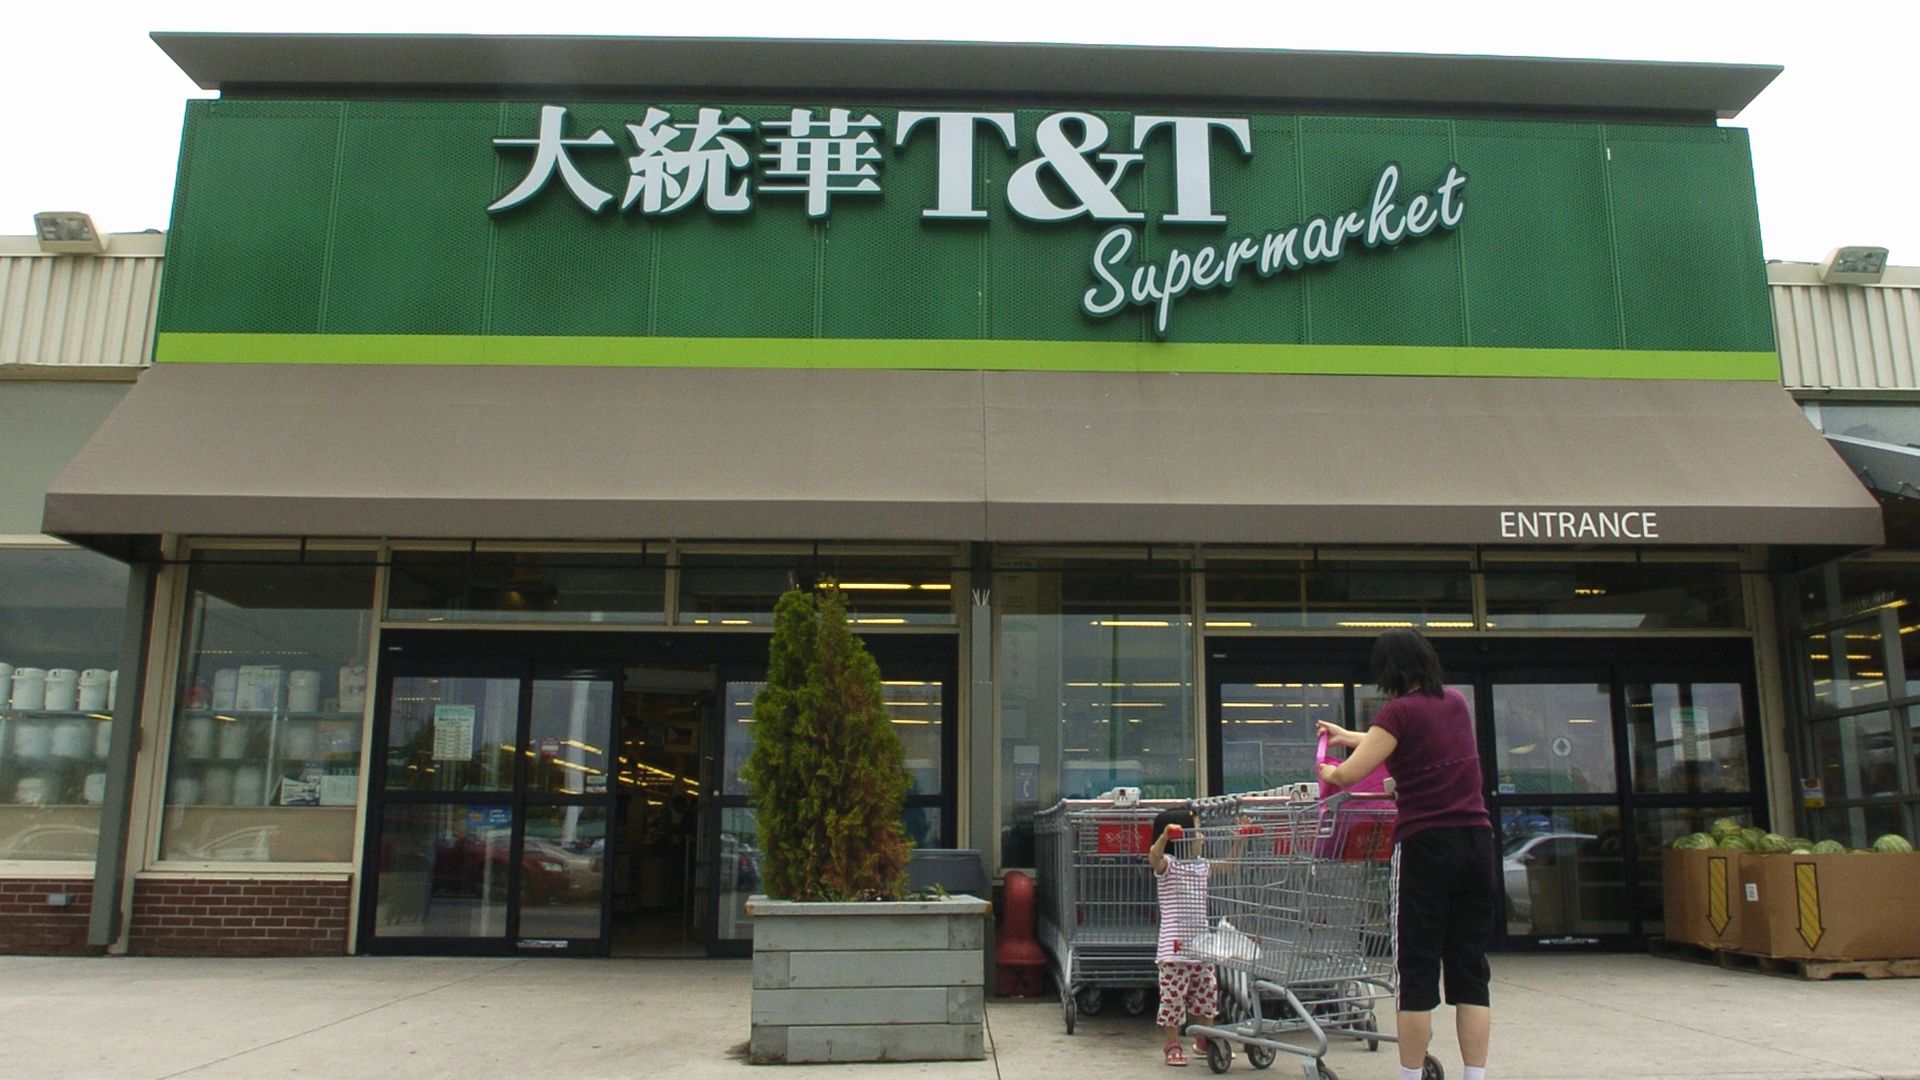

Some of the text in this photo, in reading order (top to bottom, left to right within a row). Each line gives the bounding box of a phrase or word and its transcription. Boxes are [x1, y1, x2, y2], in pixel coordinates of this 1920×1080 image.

[488, 105, 882, 217] 大統華
[896, 111, 1252, 223] T&T
[1083, 165, 1466, 332] Supermarket
[1500, 511, 1659, 538] ENTRANCE
